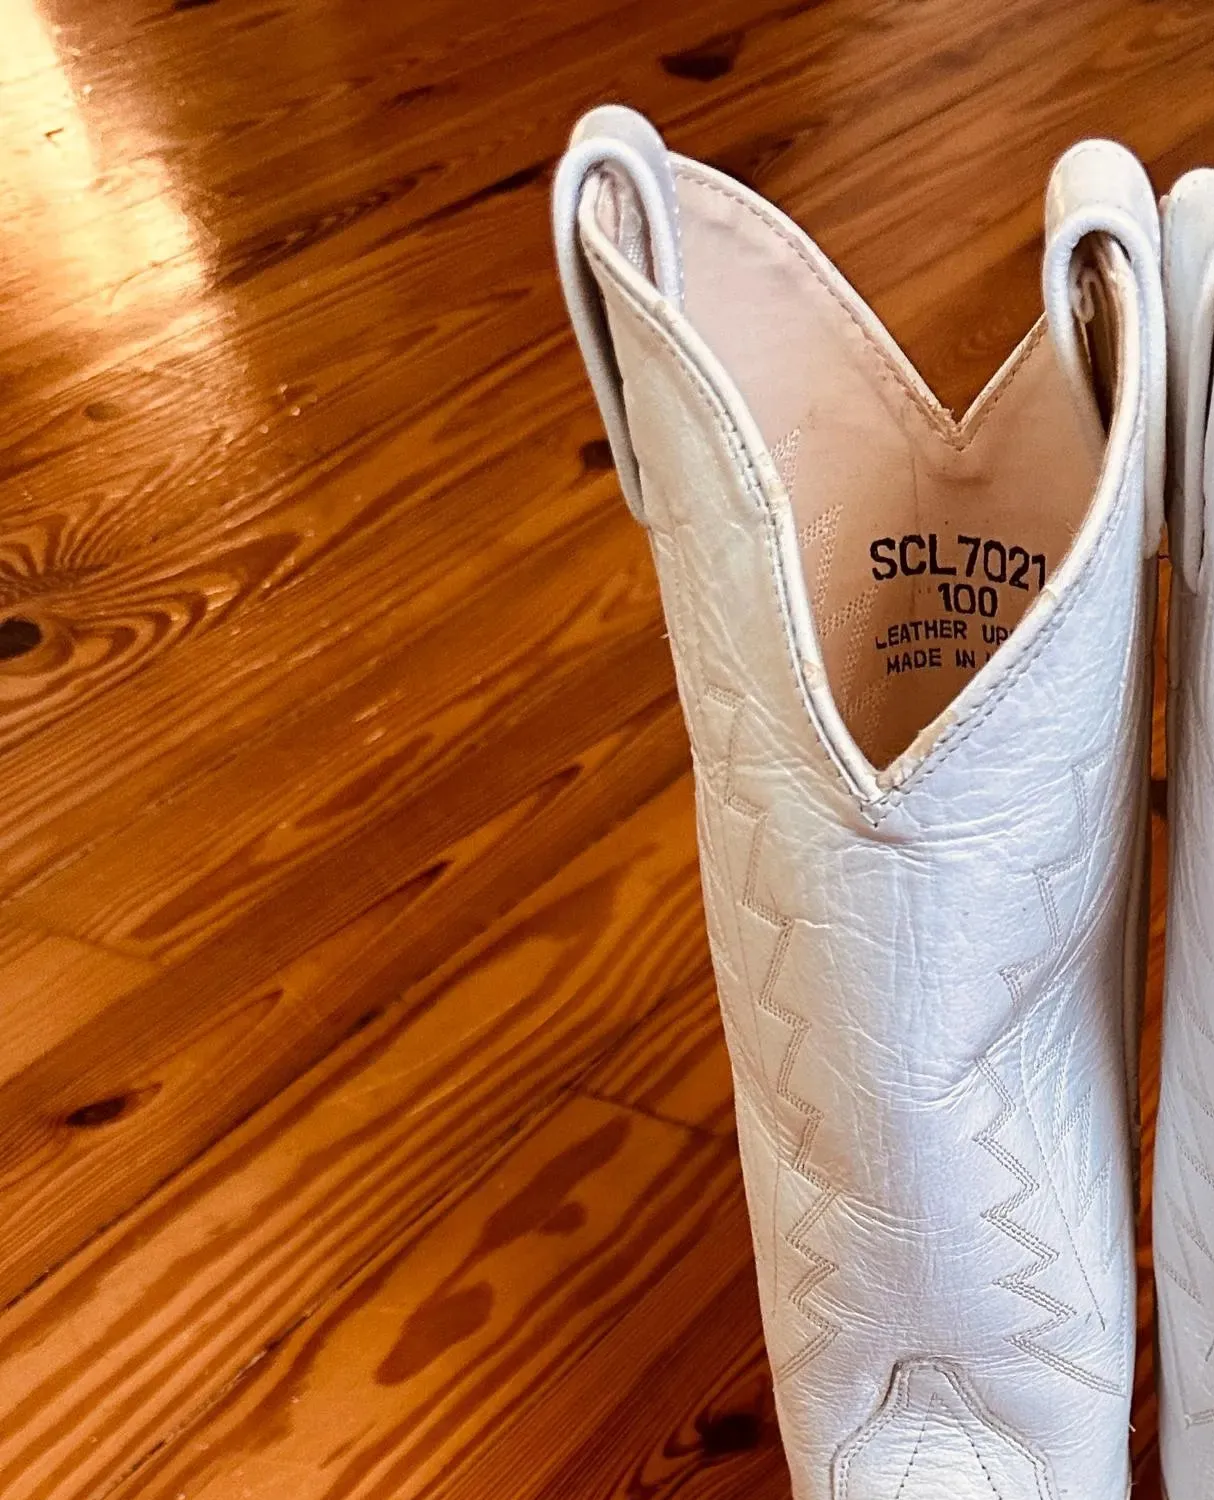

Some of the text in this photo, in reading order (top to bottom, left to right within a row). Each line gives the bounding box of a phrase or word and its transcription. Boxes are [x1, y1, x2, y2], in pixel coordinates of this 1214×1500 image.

[869, 533, 1046, 592] SCL7021
[937, 582, 998, 618] 100
[875, 620, 968, 650] LEATHER
[886, 648, 942, 676] MADE
[955, 648, 976, 669] IN
